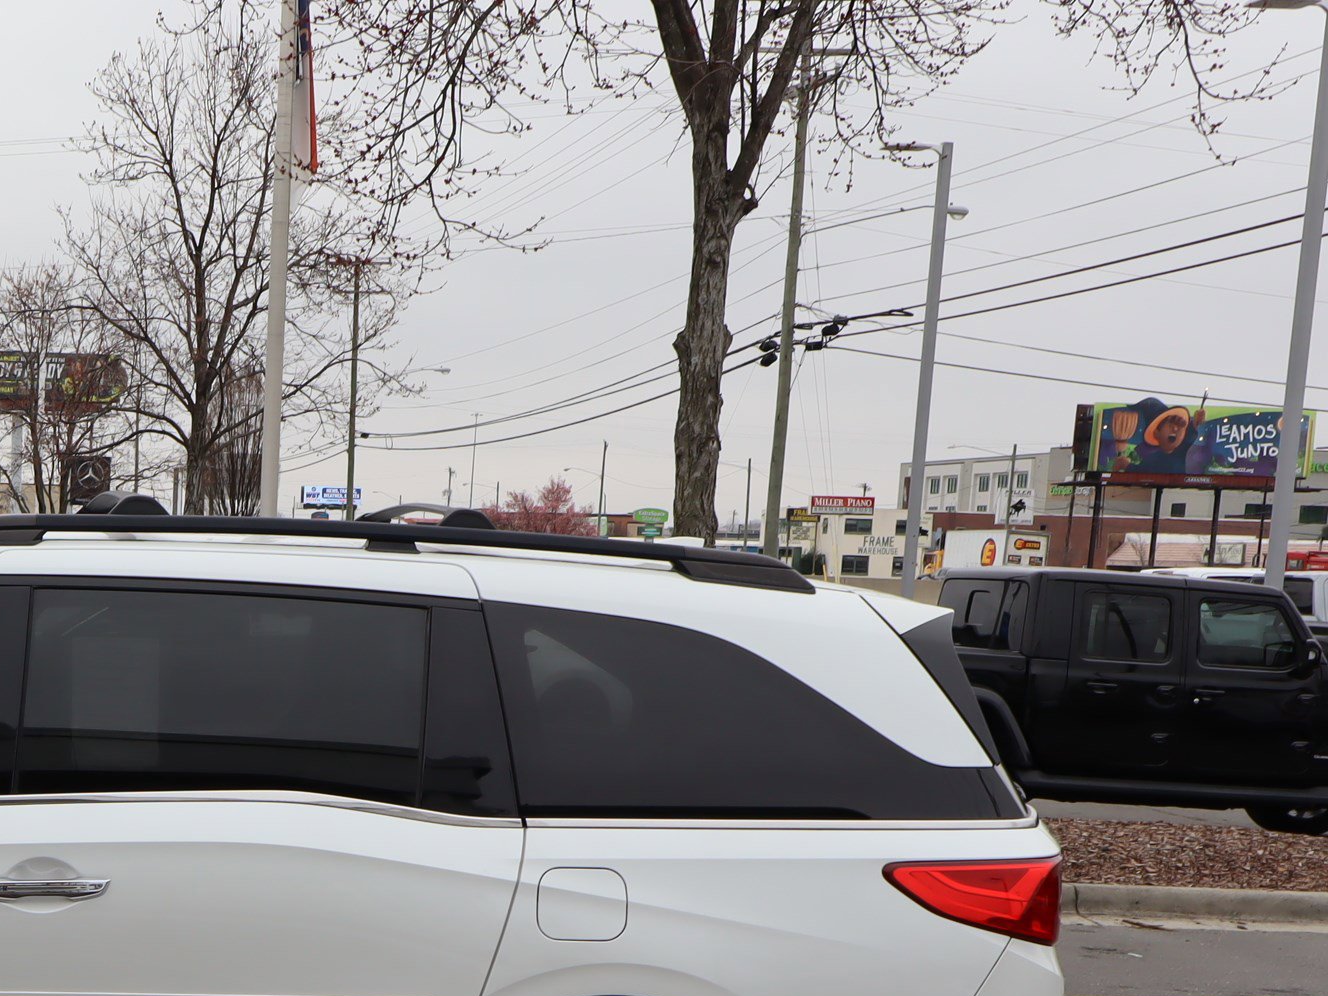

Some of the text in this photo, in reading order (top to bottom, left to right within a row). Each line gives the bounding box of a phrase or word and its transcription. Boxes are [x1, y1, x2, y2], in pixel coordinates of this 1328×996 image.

[1216, 424, 1277, 443] LEAMOS
[1224, 444, 1279, 463] JUNTO
[814, 498, 872, 507] MILLER PIANO
[863, 536, 895, 547] FRAME
[858, 547, 898, 555] WAREHOUSE
